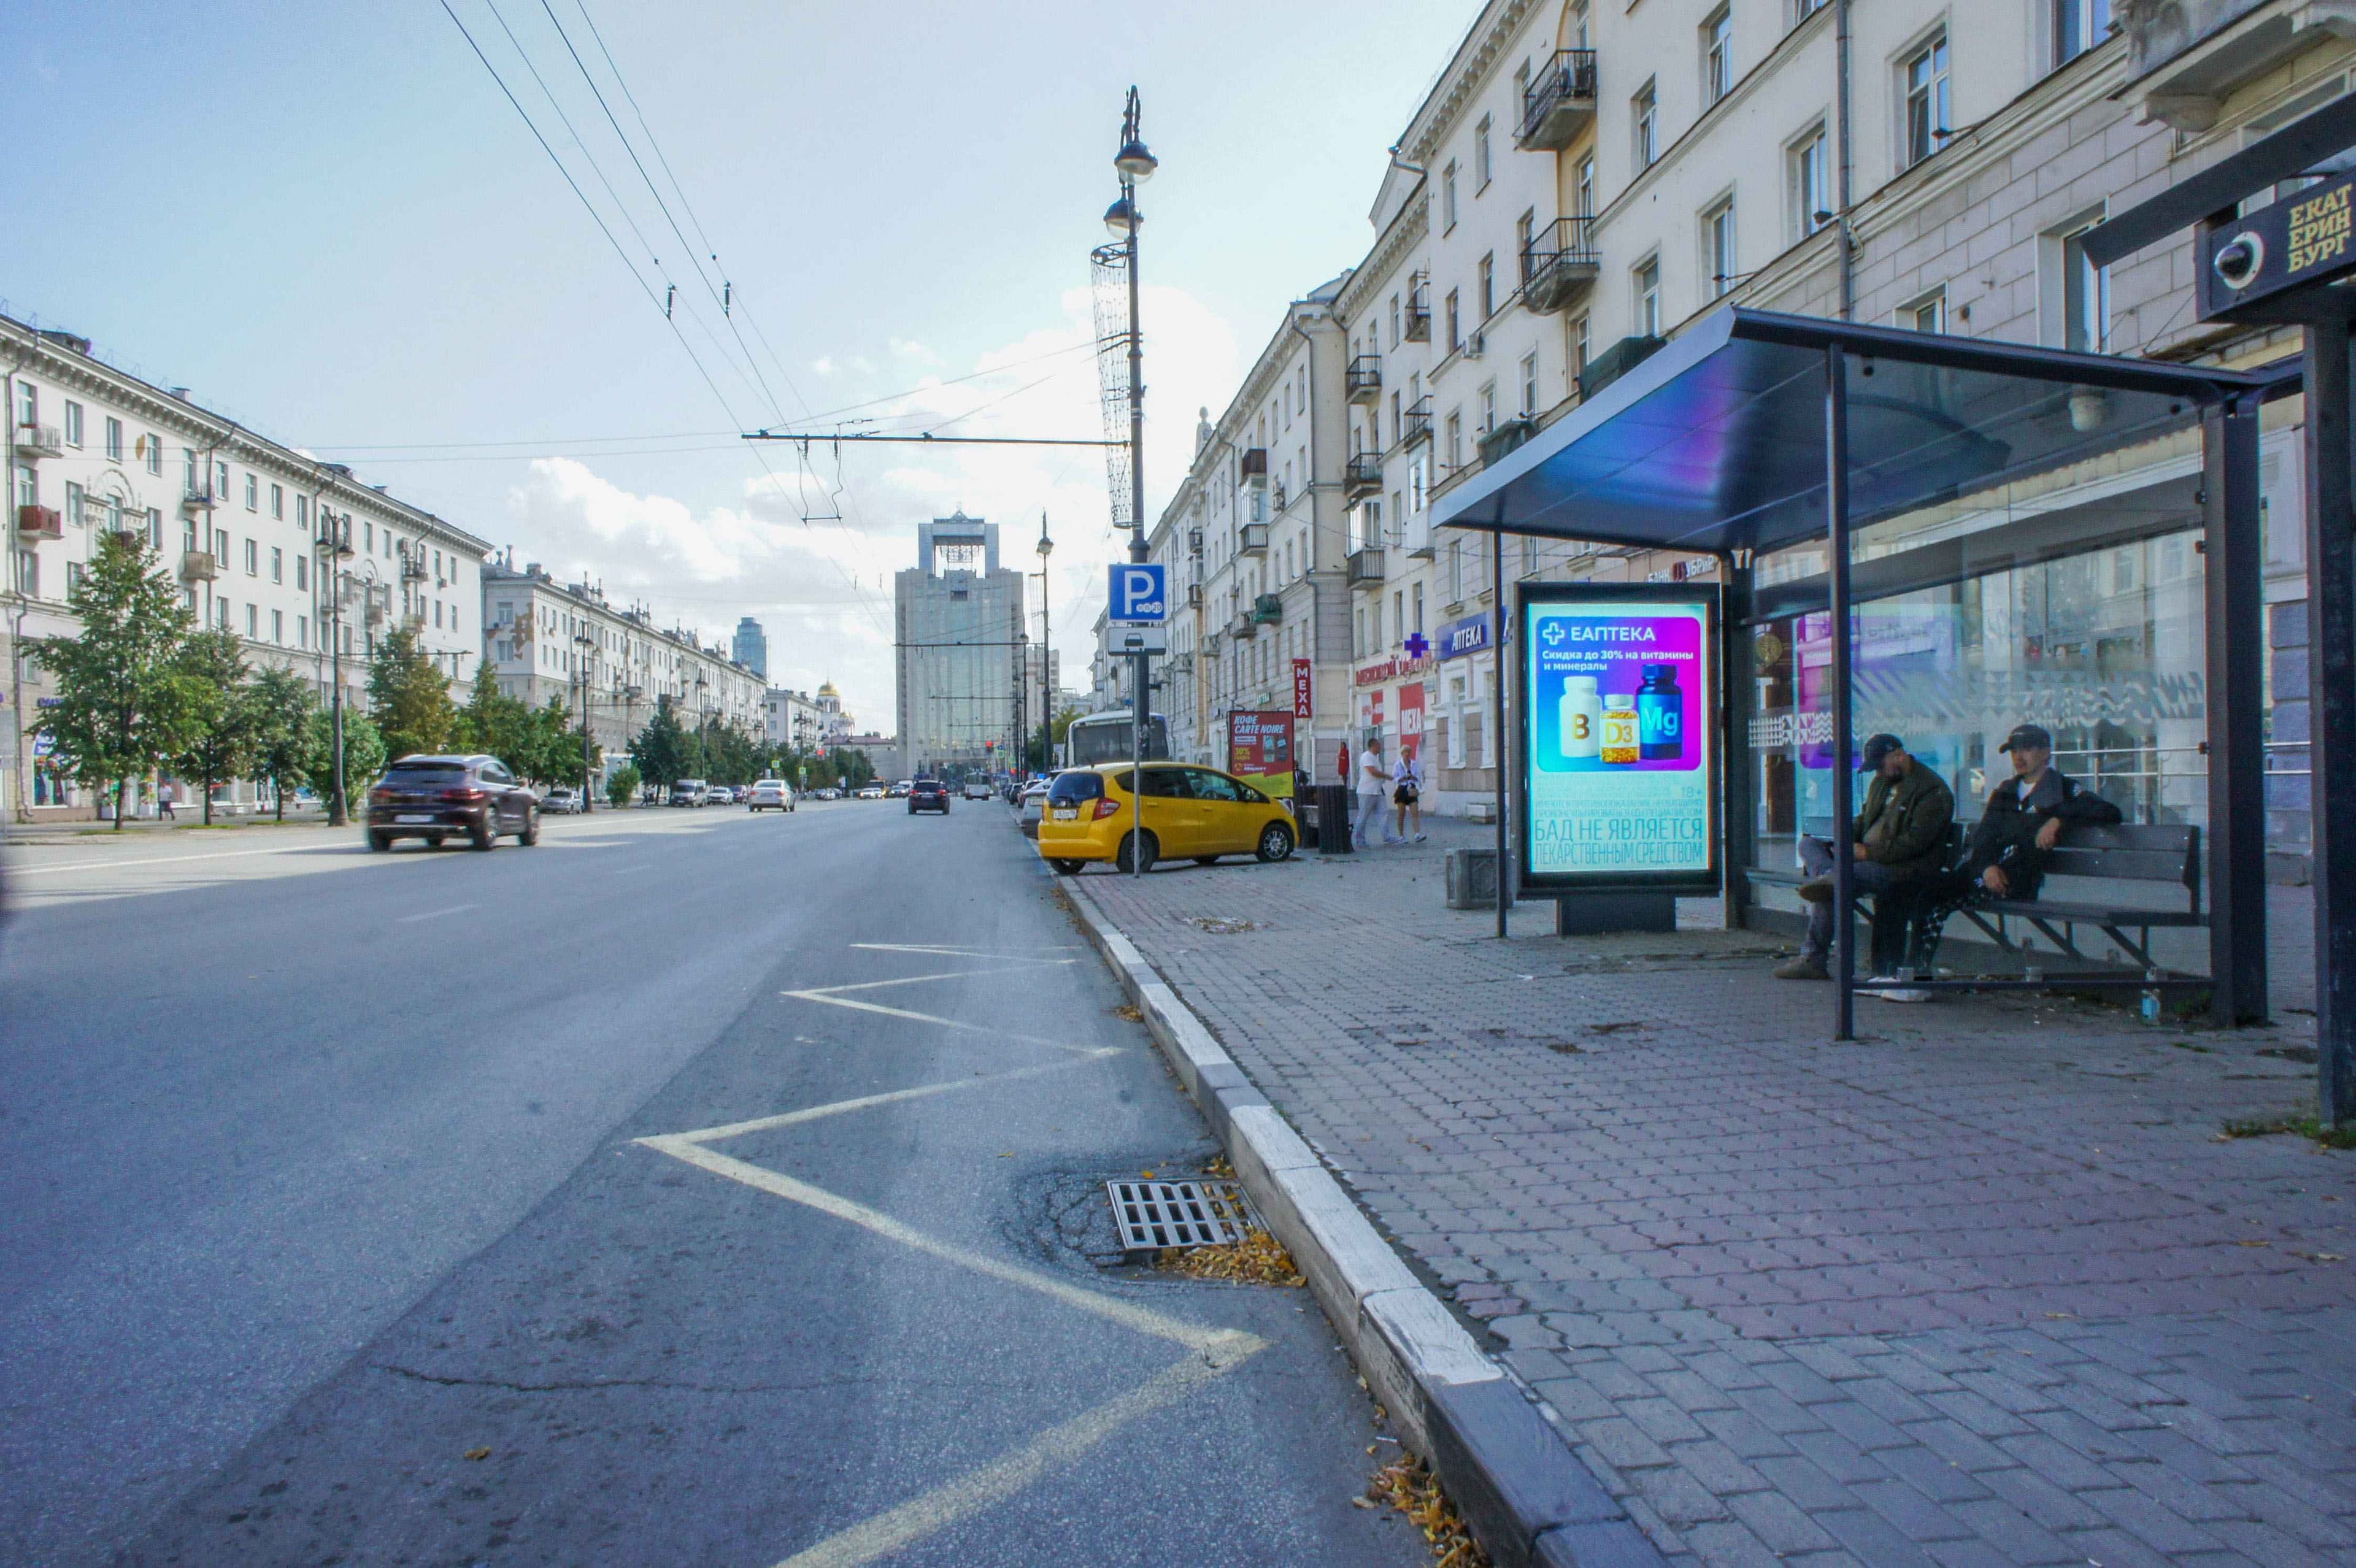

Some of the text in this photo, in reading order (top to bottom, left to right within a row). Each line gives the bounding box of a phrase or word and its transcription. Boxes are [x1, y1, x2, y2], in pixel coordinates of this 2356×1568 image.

[2289, 206, 2352, 251] ЕРИН
[2287, 230, 2352, 273] БУРГ
[1125, 571, 1155, 614] P
[1452, 624, 1482, 651] АПТЕКА
[1571, 626, 1656, 642] ЕАПТЕКА
[1542, 650, 1694, 661] Скидка до 30% на витамины
[1553, 663, 1607, 672] минералы
[1296, 667, 1309, 715] МЕХА
[1234, 715, 1258, 724] КОФЕ
[1234, 724, 1285, 734] CARTE NOIRE
[1401, 707, 1422, 735] МЕХА
[1572, 713, 1590, 740] B
[1642, 706, 1678, 736] Mg
[1605, 722, 1633, 744] D3
[1535, 818, 1703, 842] БАД НЕ ЯВЛЯЕТСЯ
[1535, 841, 1703, 864] ЛЕКАРСТВЕННЫМ СРЕДСТВОМ
